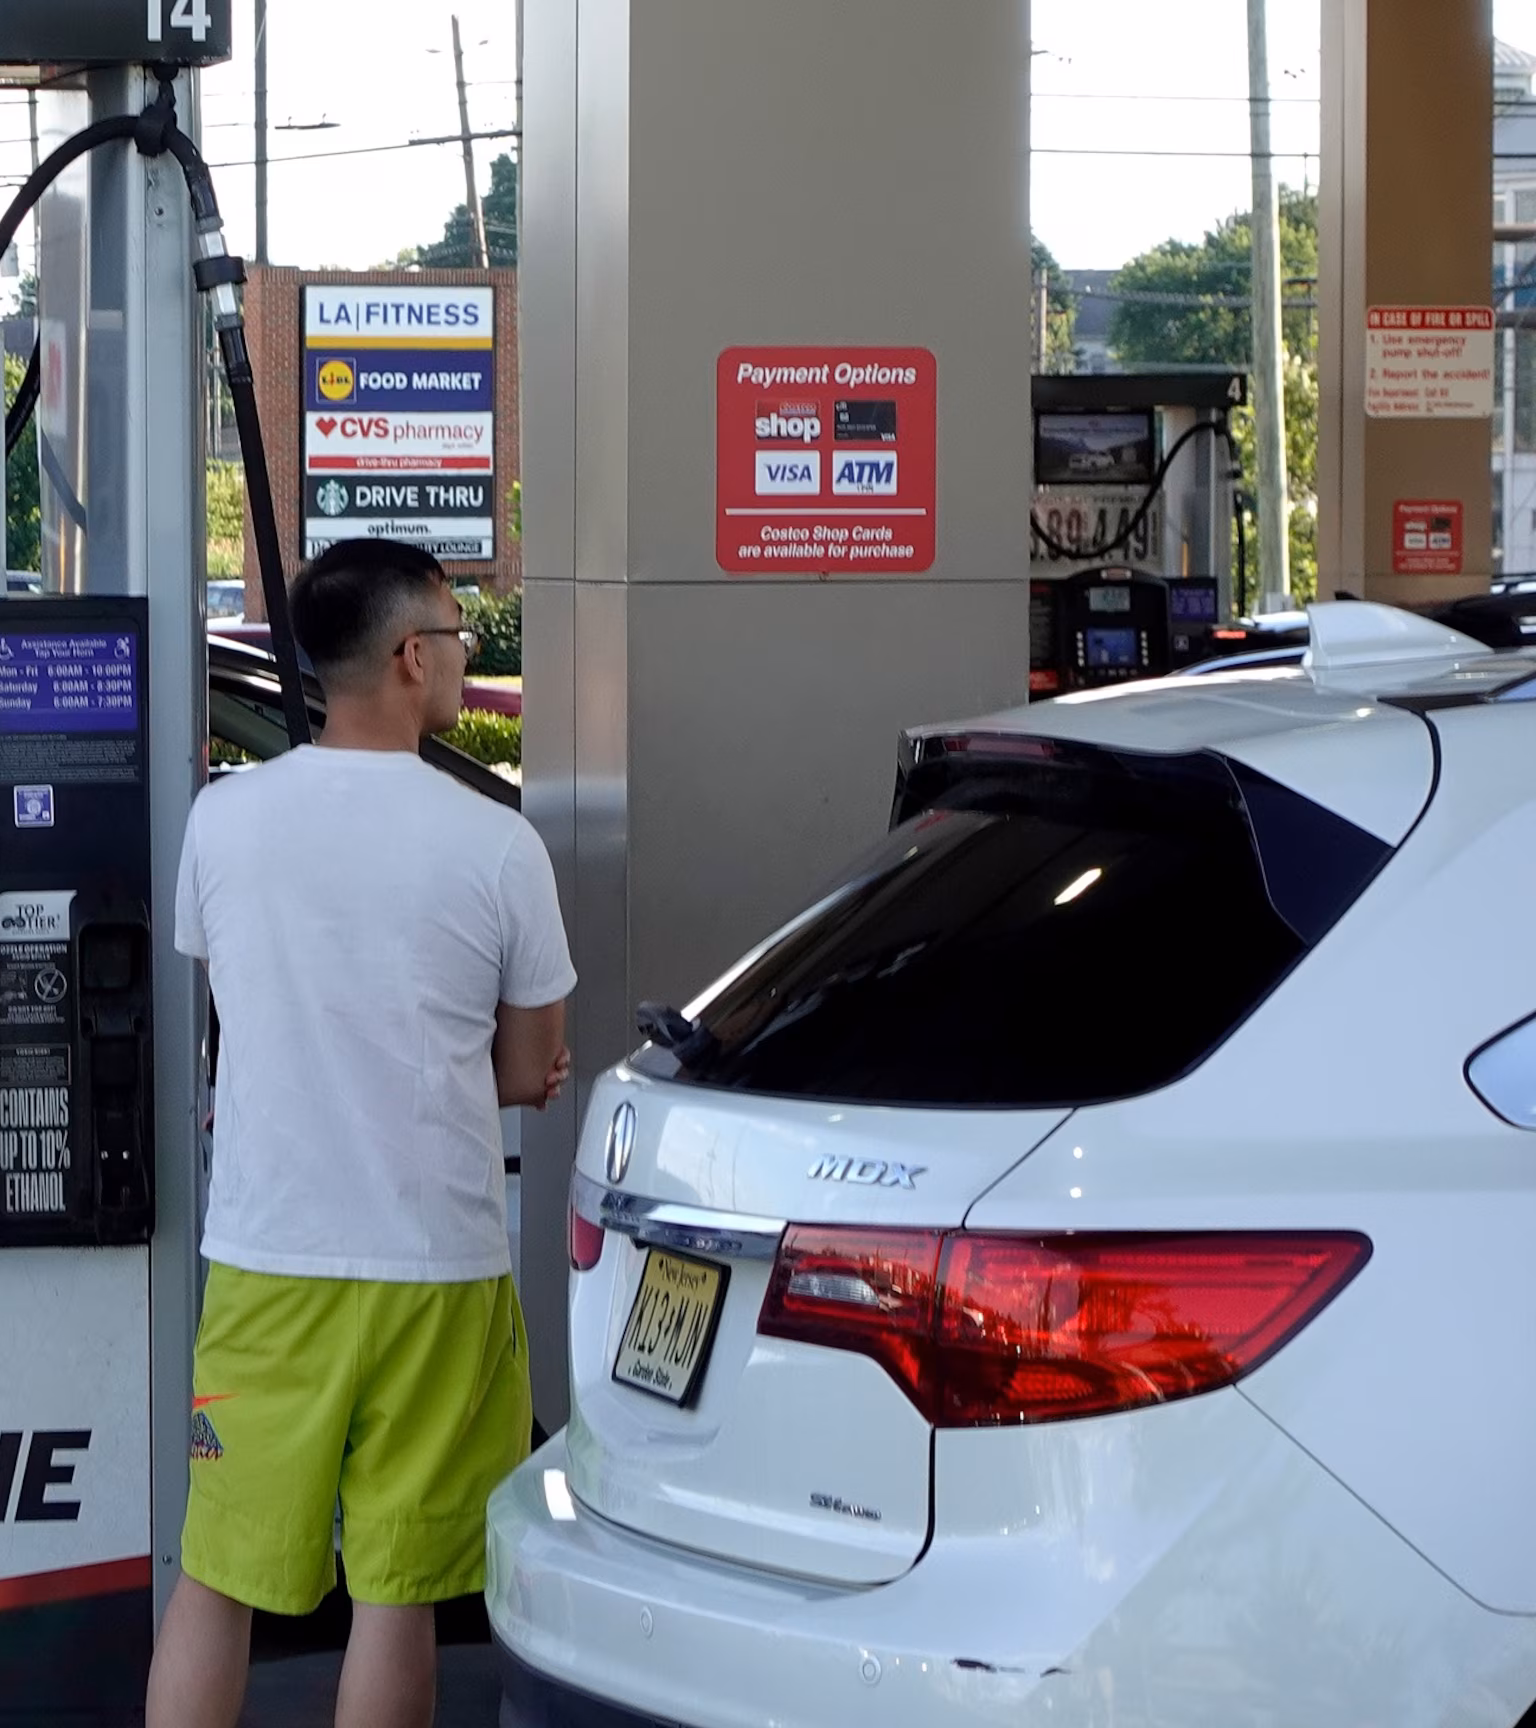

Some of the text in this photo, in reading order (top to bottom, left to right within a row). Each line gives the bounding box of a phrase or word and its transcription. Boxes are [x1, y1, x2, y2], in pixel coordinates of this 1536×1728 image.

[147, 0, 212, 42] 14
[319, 302, 480, 326] LA FITNESS
[1369, 312, 1491, 328] IN CASE OF FIRE OR SPILL
[1382, 334, 1402, 344] Use
[1409, 336, 1466, 346] emergency
[359, 372, 407, 391] FOOD
[413, 372, 482, 391] MARKET
[737, 362, 917, 389] Payment Options
[1383, 368, 1417, 380] Report
[1422, 368, 1438, 378] the
[1227, 377, 1242, 400] 4
[339, 417, 484, 444] CVS pharmacy
[755, 412, 821, 444] shop
[400, 458, 443, 469] pharmacy
[765, 461, 894, 484] VISA ATM
[356, 485, 484, 508] DRIVE THRU
[761, 525, 893, 543] Costco Shop Cards
[738, 543, 915, 561] are available for purchase
[21, 638, 107, 649] Assistance Available
[35, 649, 94, 659] Tap Your Horn
[26, 665, 38, 677] Fri
[92, 664, 131, 677] 10:00PM
[16, 904, 44, 917] TOP
[27, 916, 57, 930] TIER
[0, 1087, 69, 1128] CONTAINS
[0, 1129, 71, 1170] UP TO 10%
[807, 1154, 928, 1190] MDX
[6, 1171, 66, 1212] ETHANOL
